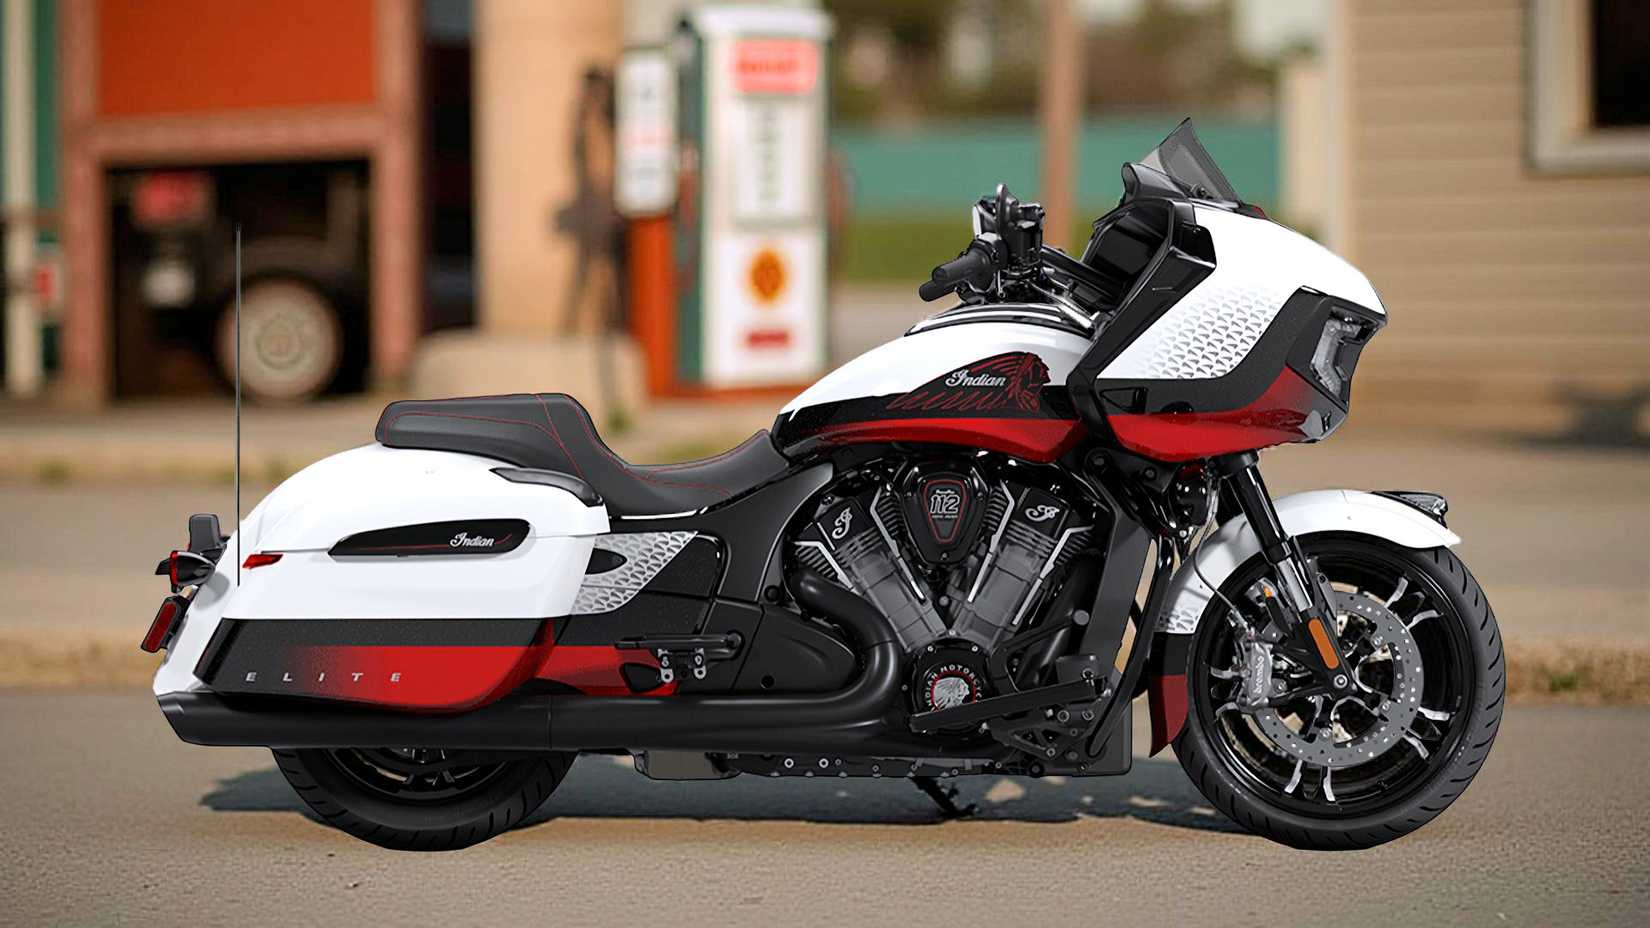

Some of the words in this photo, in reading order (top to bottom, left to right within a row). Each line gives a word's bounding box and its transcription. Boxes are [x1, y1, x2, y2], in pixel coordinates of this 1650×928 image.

[945, 368, 1007, 387] Indian
[930, 494, 961, 514] 112
[449, 532, 495, 548] Indian
[245, 672, 401, 682] ELITE
[940, 664, 983, 703] MOTORCYC
